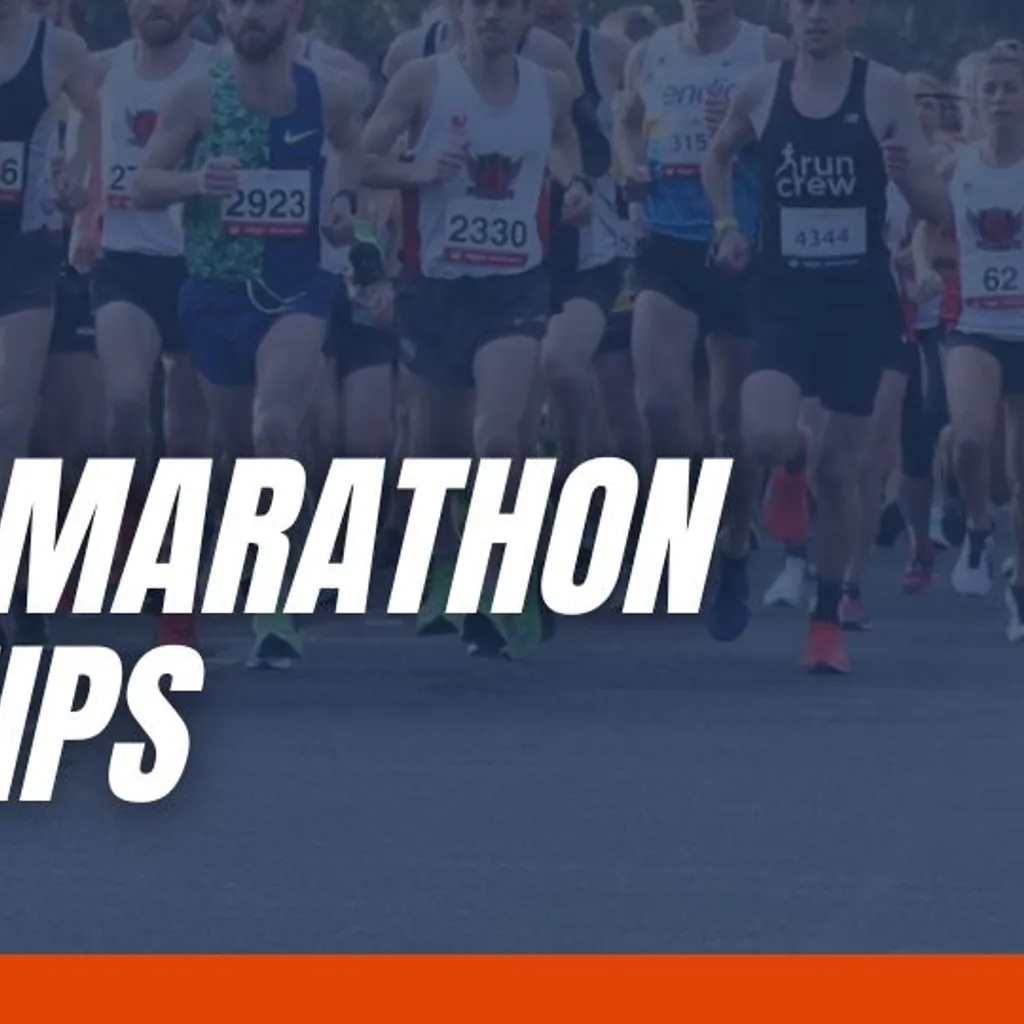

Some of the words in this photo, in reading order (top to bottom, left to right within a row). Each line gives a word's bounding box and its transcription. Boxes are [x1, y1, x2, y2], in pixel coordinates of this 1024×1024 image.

[801, 155, 854, 175] run
[777, 177, 856, 197] crew
[226, 189, 306, 218] 2923
[449, 214, 528, 248] 2330
[983, 266, 1018, 291] 62
